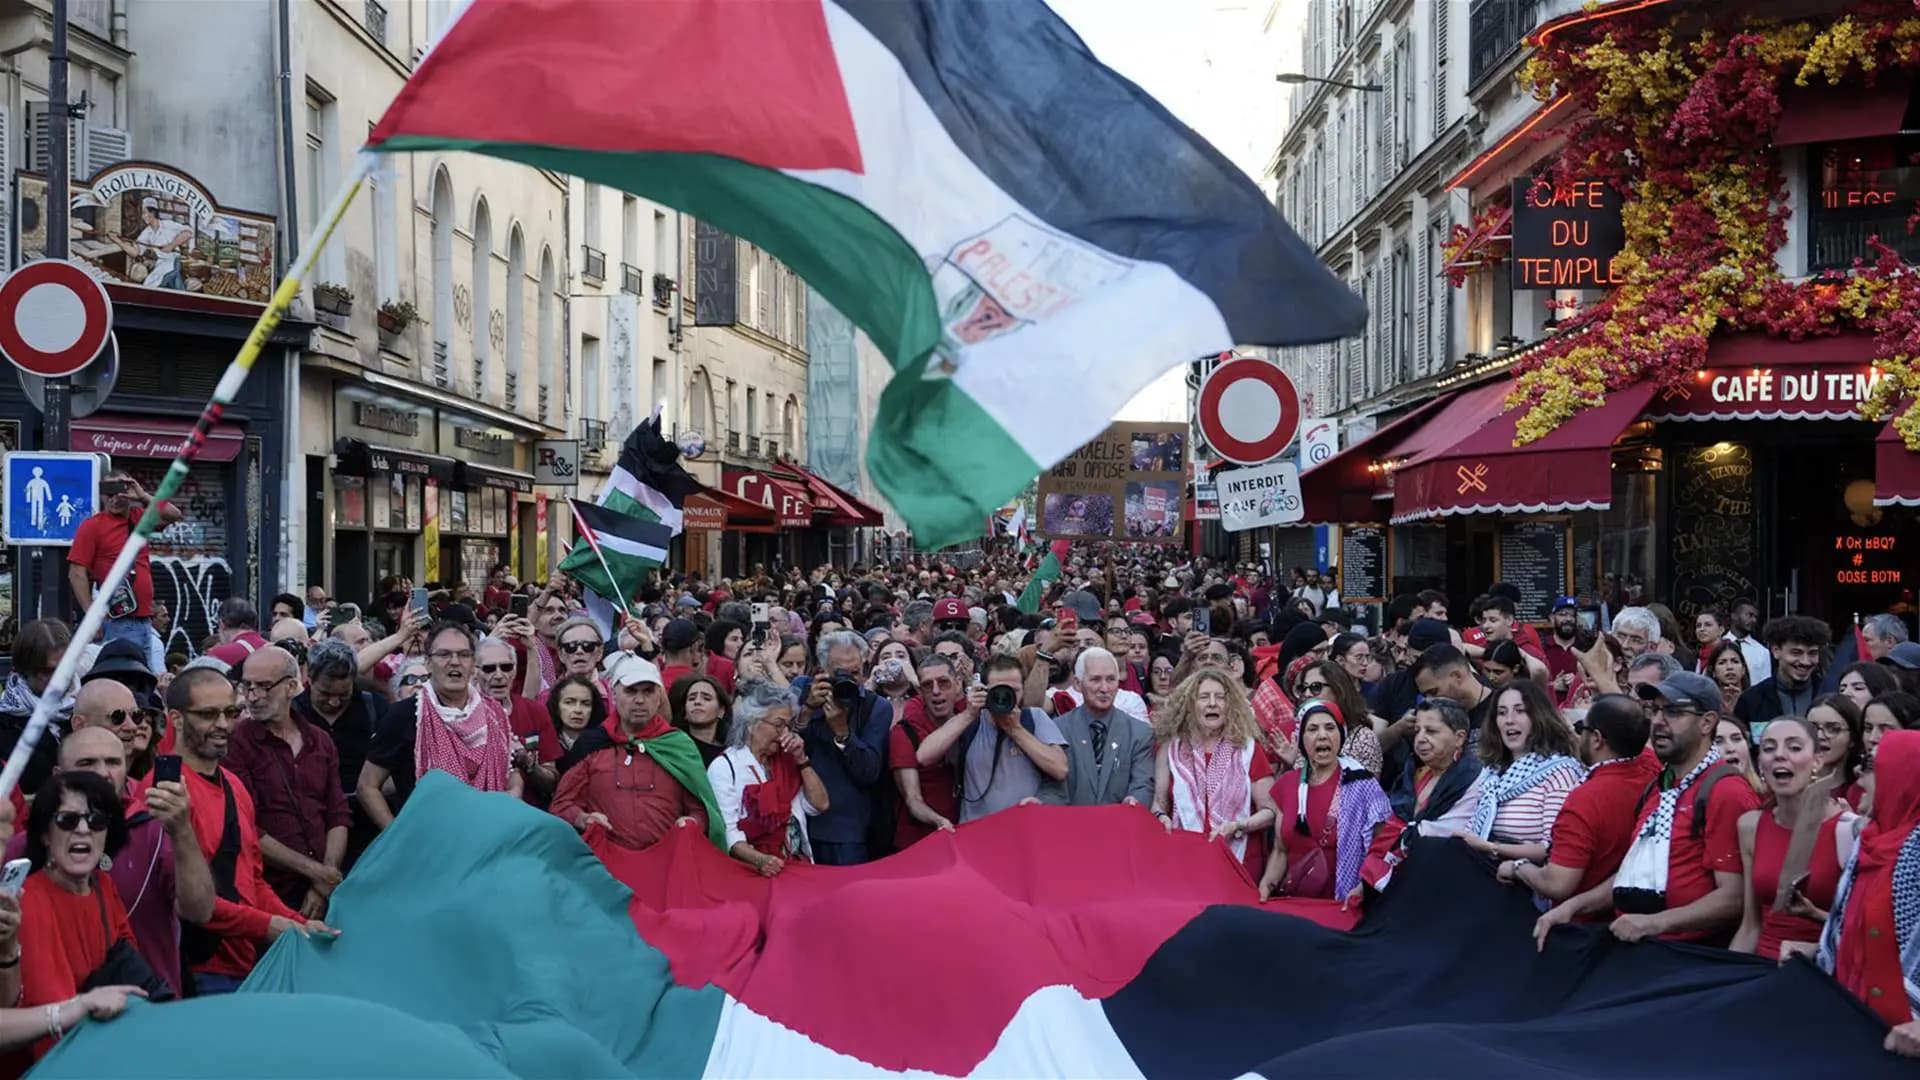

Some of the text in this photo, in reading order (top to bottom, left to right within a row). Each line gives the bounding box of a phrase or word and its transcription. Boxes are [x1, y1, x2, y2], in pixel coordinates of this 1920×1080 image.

[98, 173, 211, 220] BOULANGERIE
[1552, 220, 1589, 246] DU
[1518, 257, 1626, 285] TEMPLE
[1711, 369, 1773, 402] CAFÉ
[1783, 371, 1818, 401] DU
[92, 433, 132, 454] Crêpes
[1084, 461, 1126, 479] OPPOSE
[1228, 474, 1284, 493] INTERDIT
[737, 475, 804, 515] CAFE
[1224, 499, 1257, 514] SAUF
[1846, 536, 1862, 549] OR
[1872, 570, 1901, 583] BOTH
[947, 602, 958, 615] S
